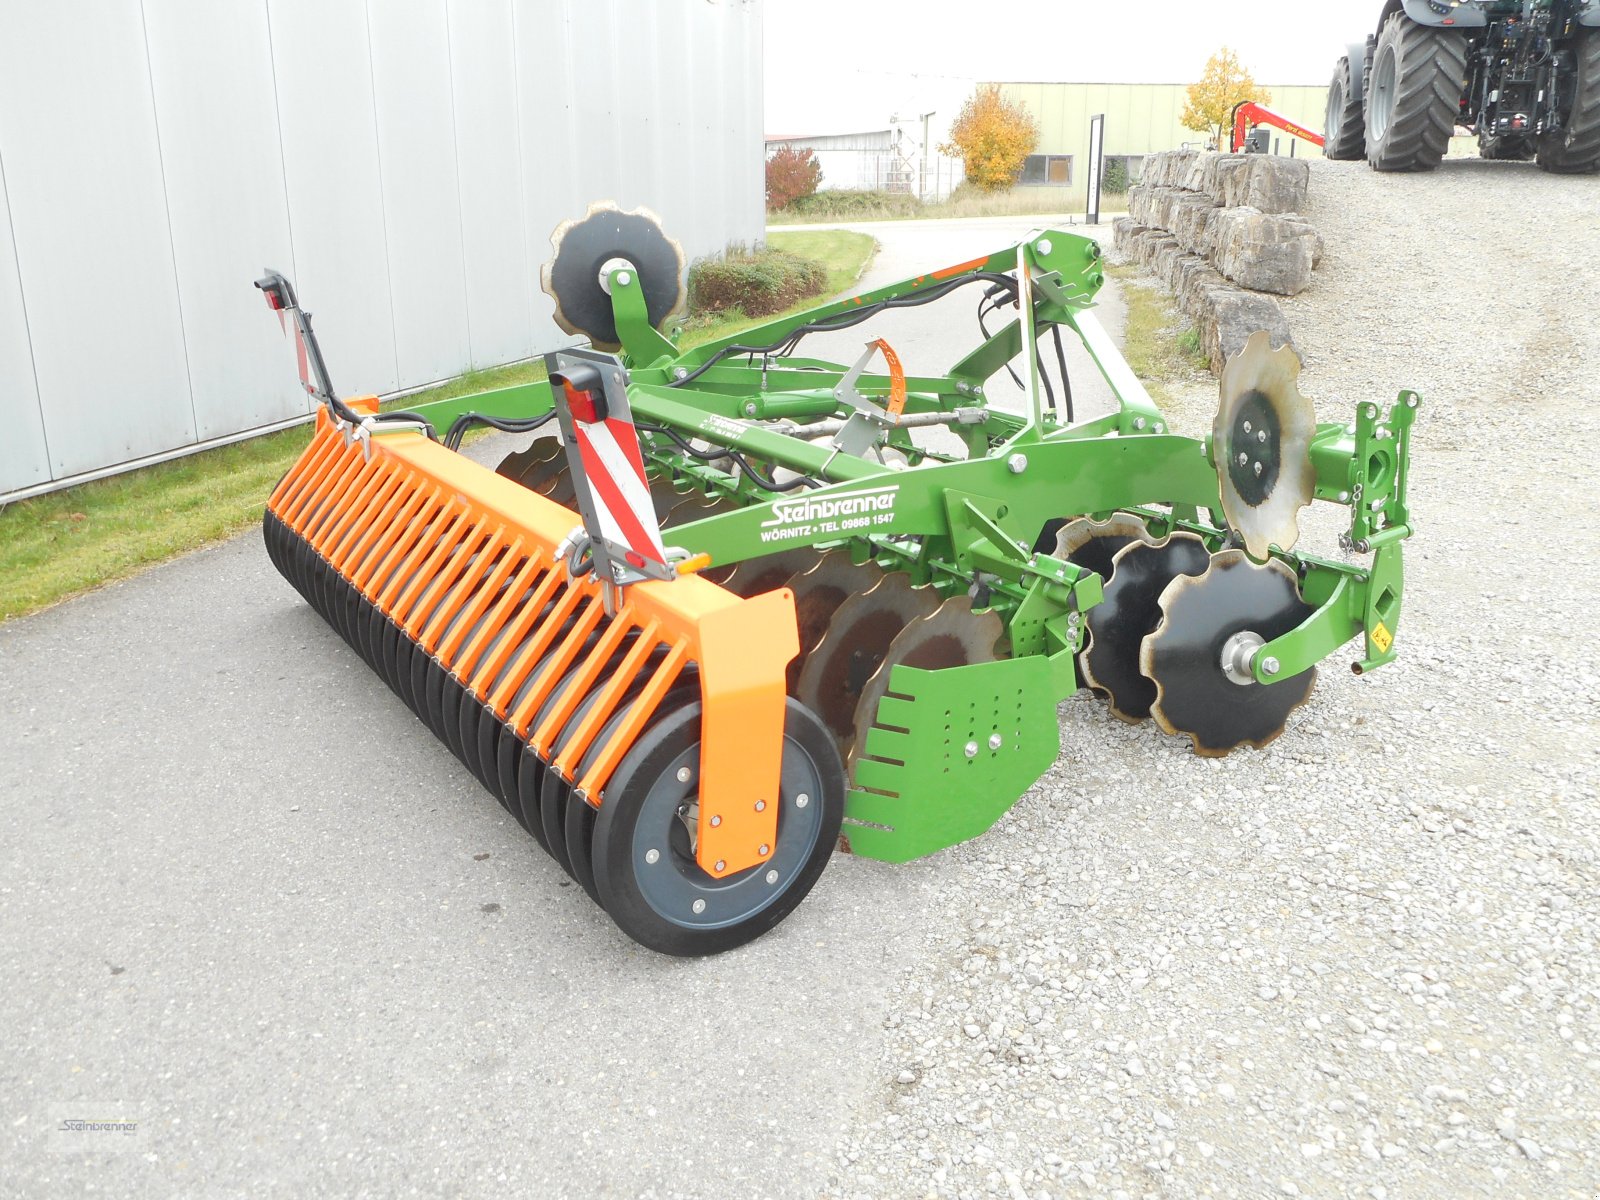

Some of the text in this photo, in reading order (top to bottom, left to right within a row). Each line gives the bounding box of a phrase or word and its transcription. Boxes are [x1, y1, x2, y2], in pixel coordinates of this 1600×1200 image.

[761, 486, 898, 527] Steinbrenner
[761, 513, 895, 542] WÖRNITZ TEL 09868 1547
